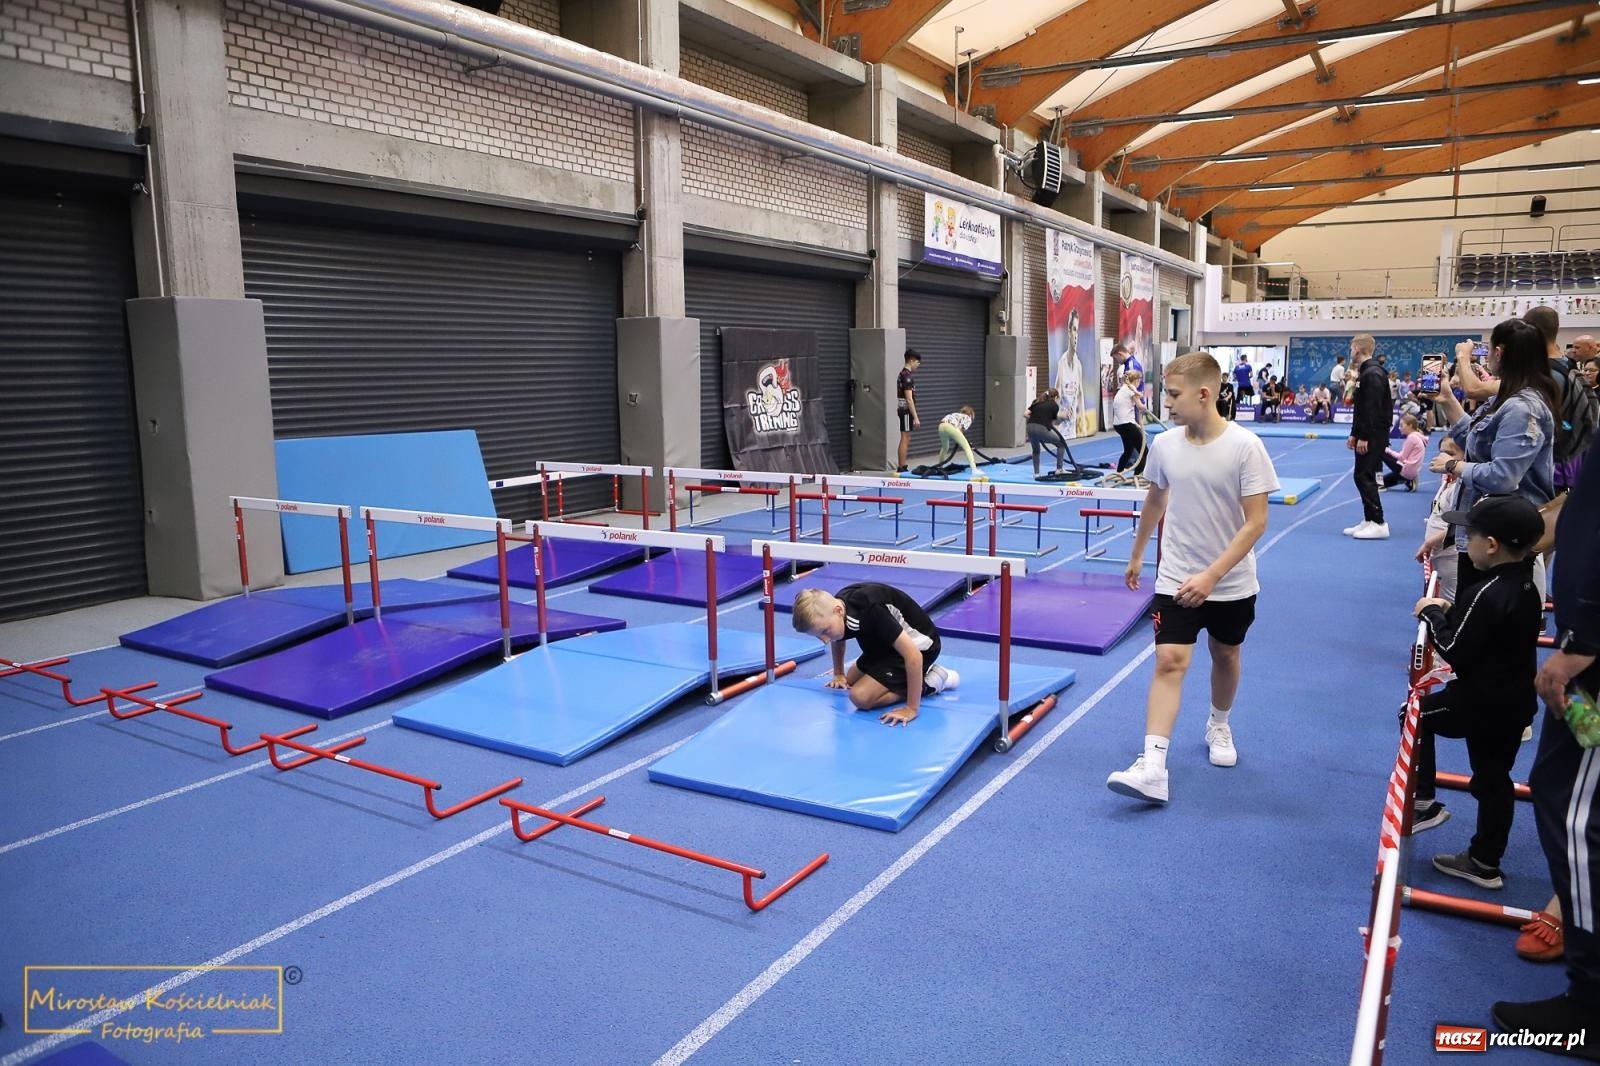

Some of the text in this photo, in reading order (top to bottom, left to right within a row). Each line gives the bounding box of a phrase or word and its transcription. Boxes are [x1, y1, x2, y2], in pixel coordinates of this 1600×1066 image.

[722, 471, 744, 479] polanik
[887, 479, 912, 488] polanik
[1065, 488, 1094, 497] polanik
[423, 515, 446, 525] polanik
[609, 531, 638, 541] polanik
[867, 553, 908, 564] polanik
